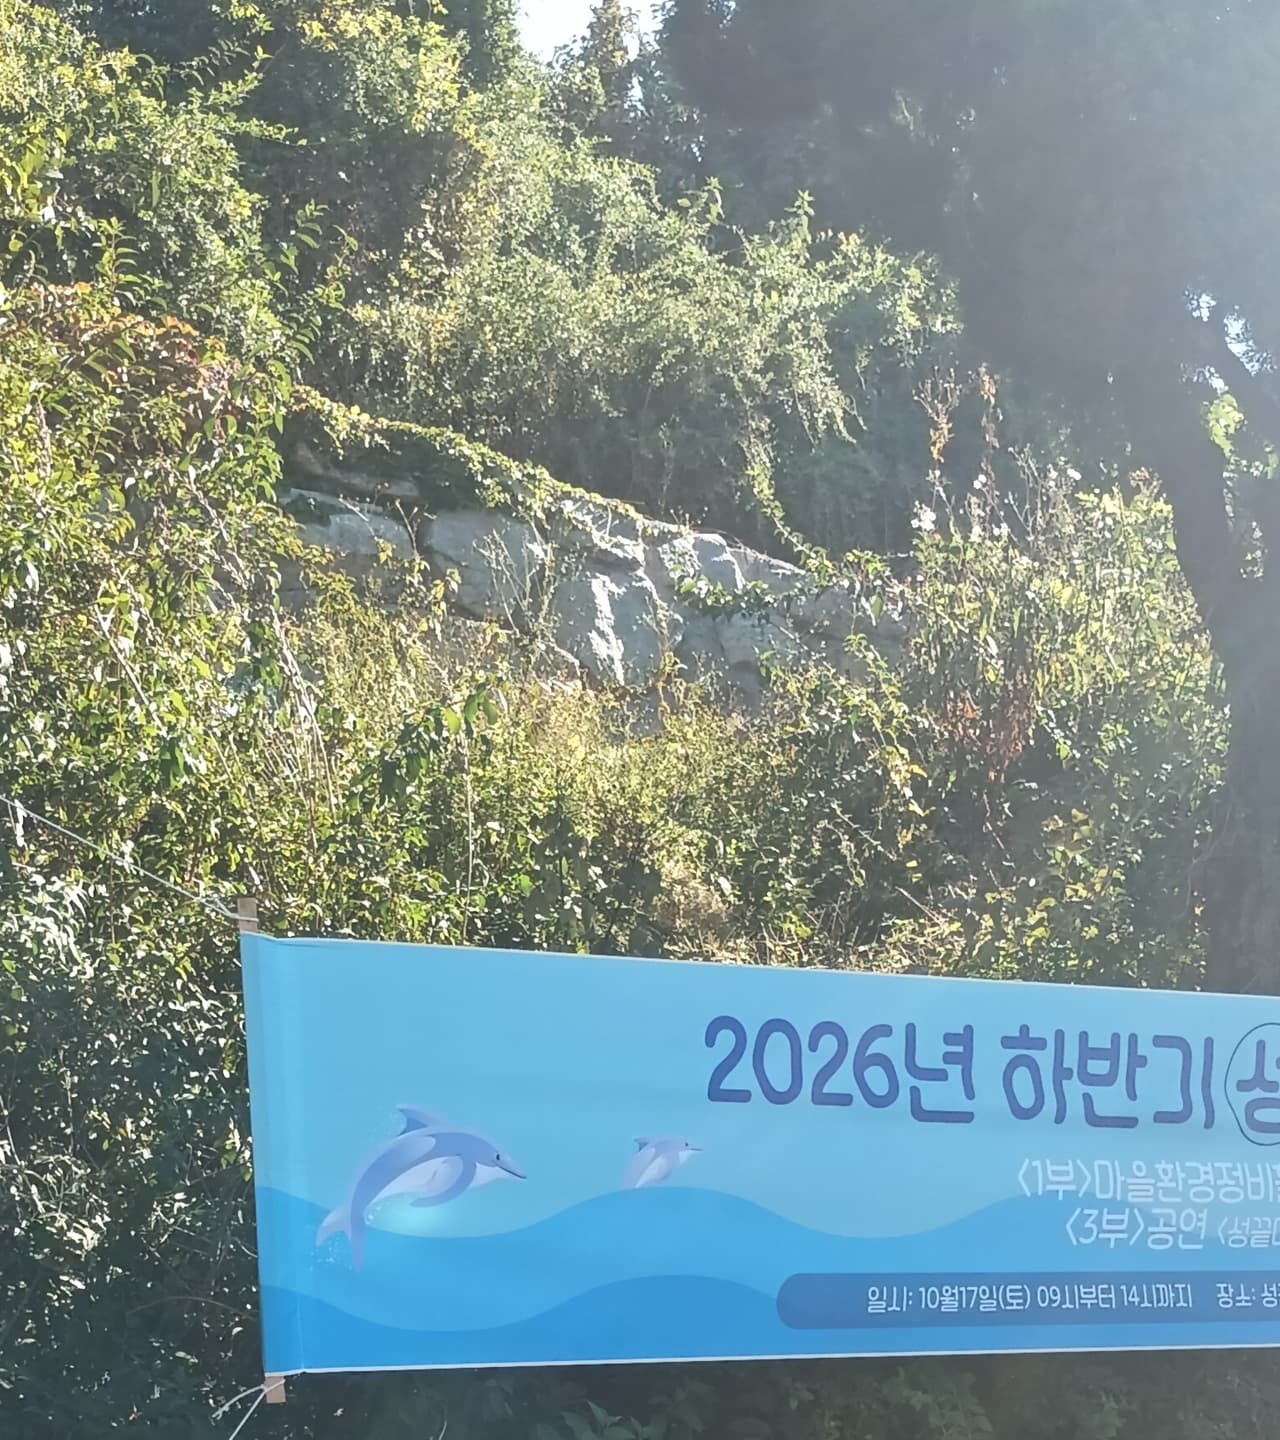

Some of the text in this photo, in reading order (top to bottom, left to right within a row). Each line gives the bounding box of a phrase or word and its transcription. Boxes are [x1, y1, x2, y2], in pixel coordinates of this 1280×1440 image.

[704, 1014, 976, 1124] 2026년
[1000, 1023, 1215, 1130] 하반기
[868, 1285, 913, 1313] 일시:
[1037, 1284, 1116, 1310] 09시부터
[1120, 1283, 1193, 1308] 14시까지
[1216, 1283, 1256, 1309] 장소:
